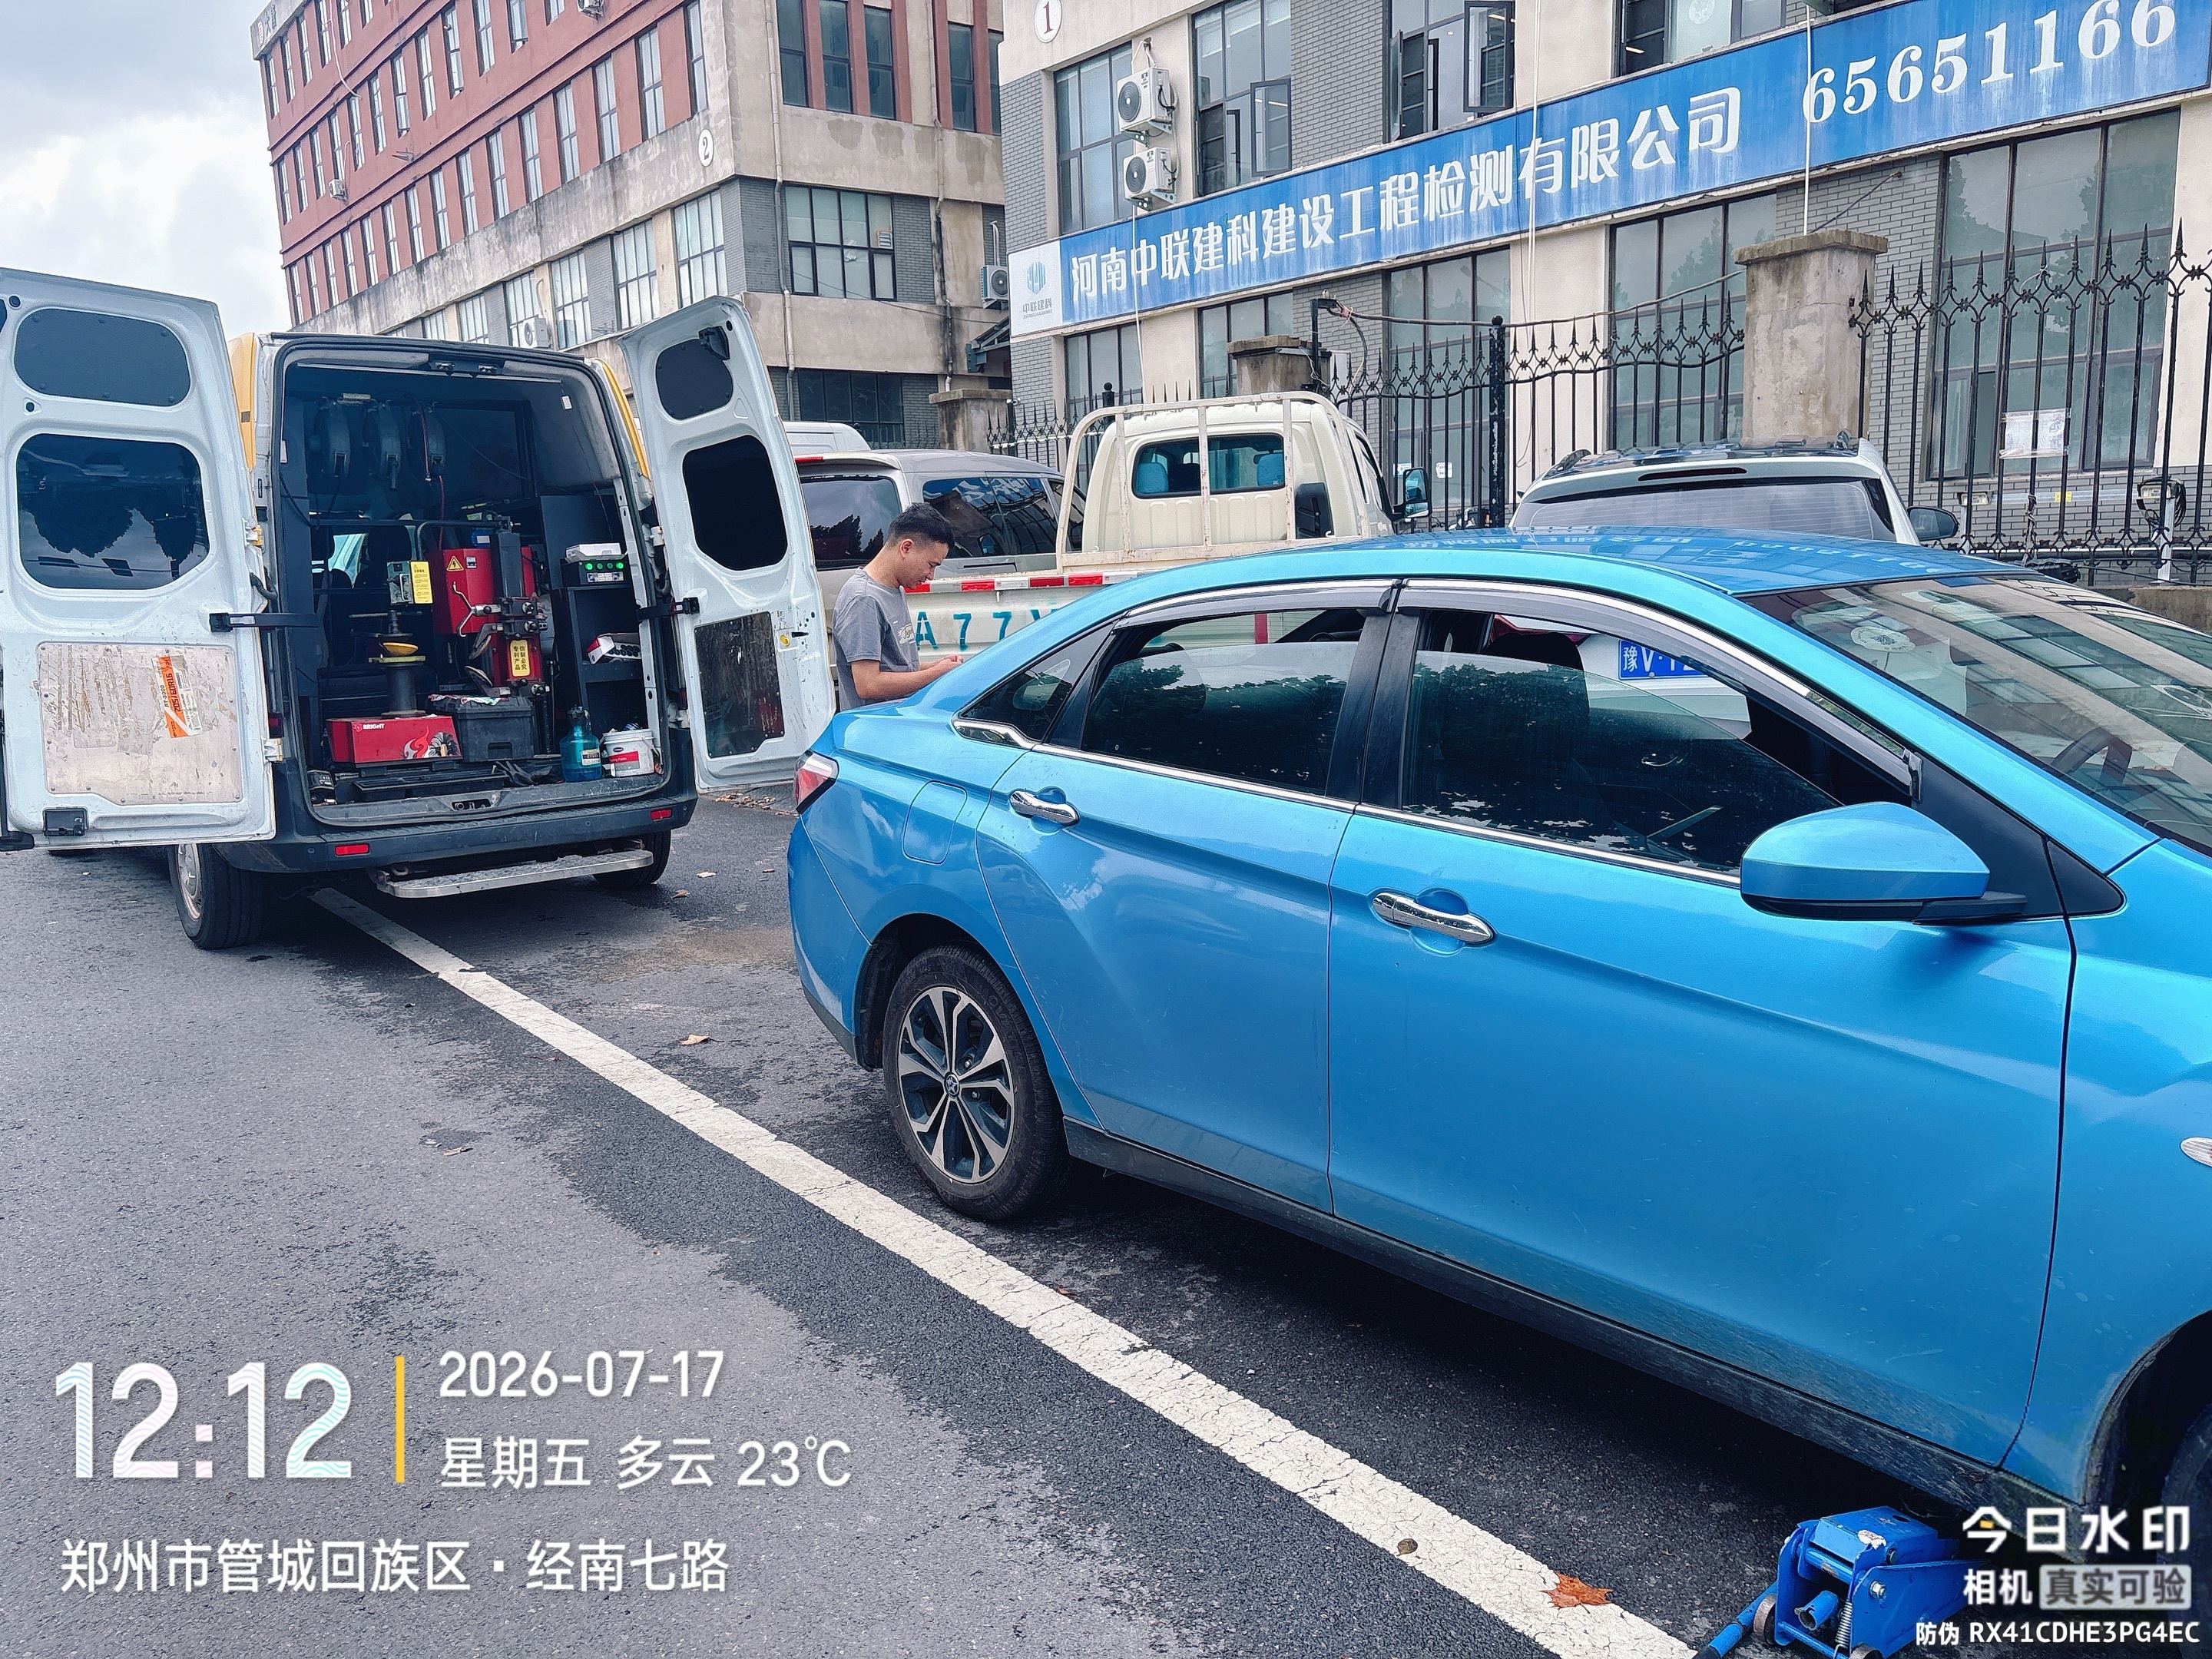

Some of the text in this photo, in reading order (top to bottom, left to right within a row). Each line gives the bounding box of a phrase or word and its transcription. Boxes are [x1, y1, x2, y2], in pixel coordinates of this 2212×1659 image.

[1043, 1, 1053, 34] 1
[703, 137, 710, 160] 2
[1071, 0, 2175, 302] 河南中联建科建设工程检测有限公司 65651166
[1022, 297, 1052, 313] 中联建科
[1623, 645, 1696, 672] 豫V·
